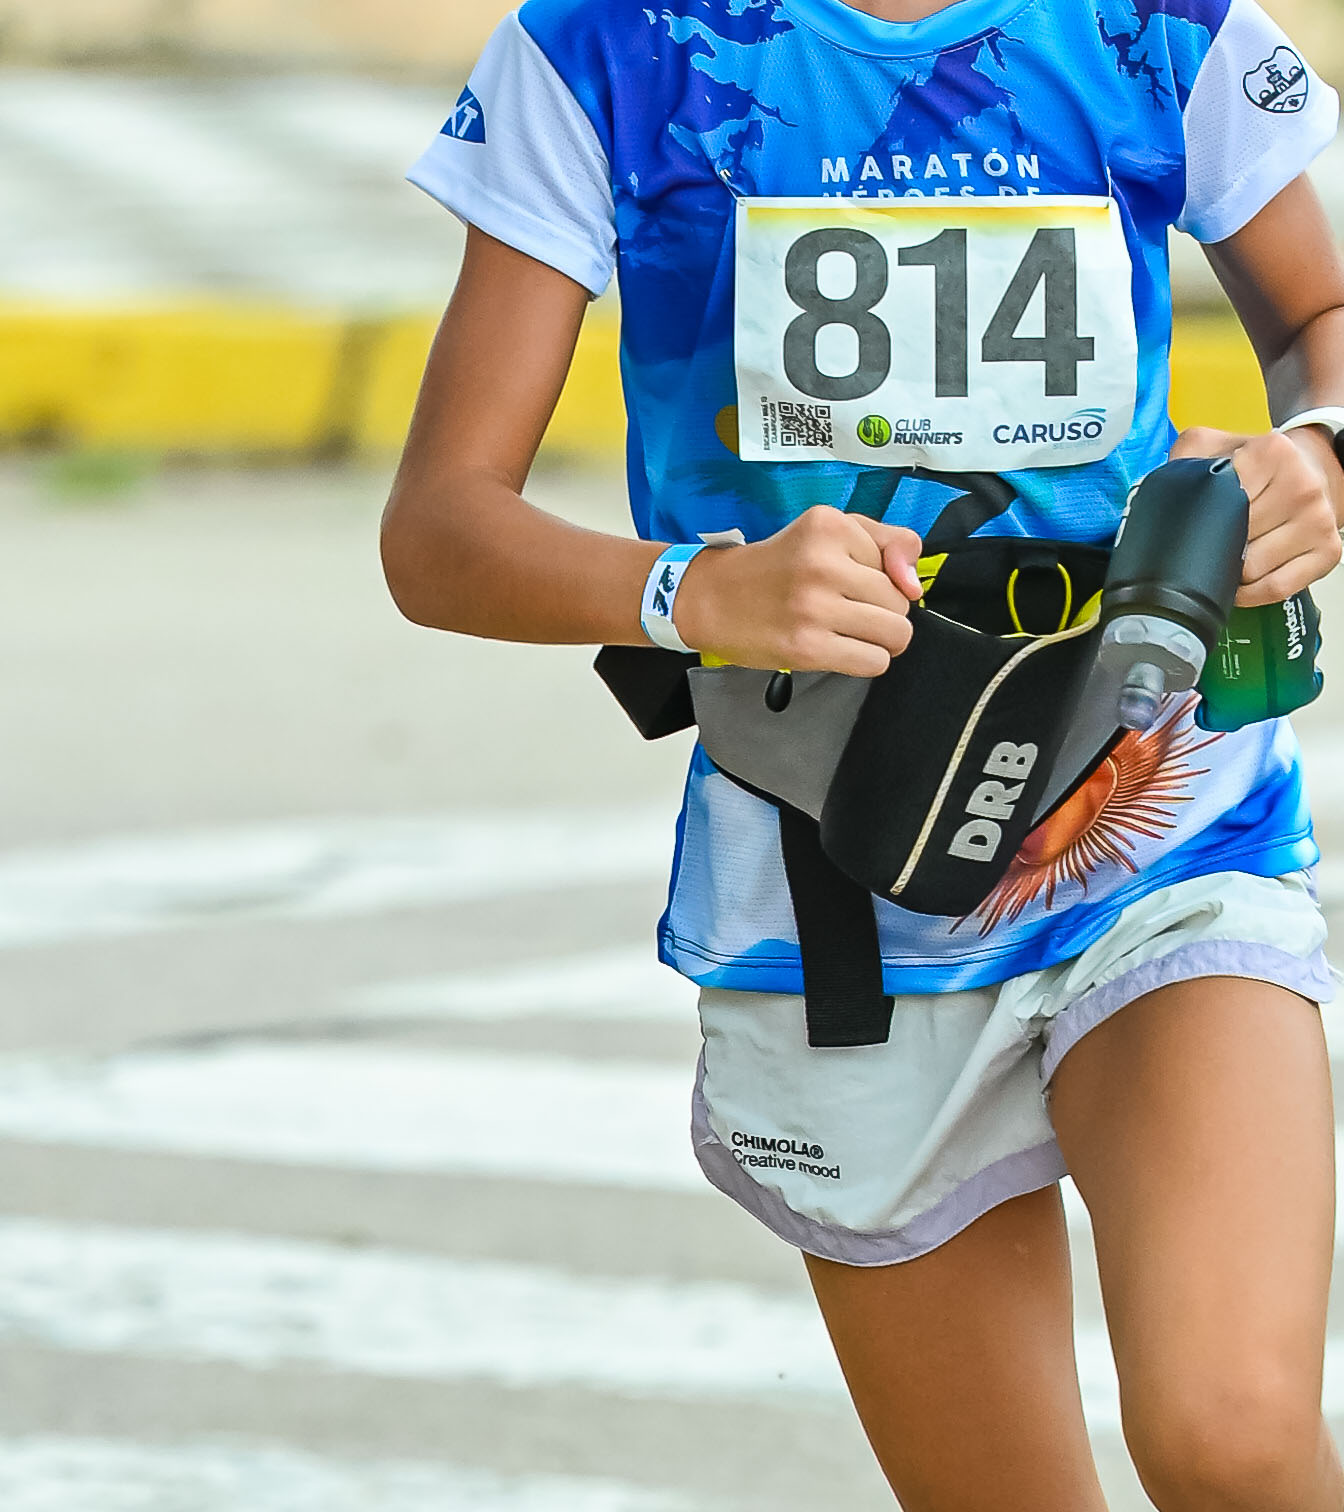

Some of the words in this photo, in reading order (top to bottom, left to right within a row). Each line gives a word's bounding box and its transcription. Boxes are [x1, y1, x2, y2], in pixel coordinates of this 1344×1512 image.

[821, 147, 1040, 184] MARATÓN
[783, 227, 1095, 401] 814
[895, 419, 932, 432] CLUB
[992, 421, 1103, 444] CARUSO
[946, 741, 1039, 863] DRB
[732, 1148, 796, 1171] Creative
[798, 1161, 841, 1180] mood
